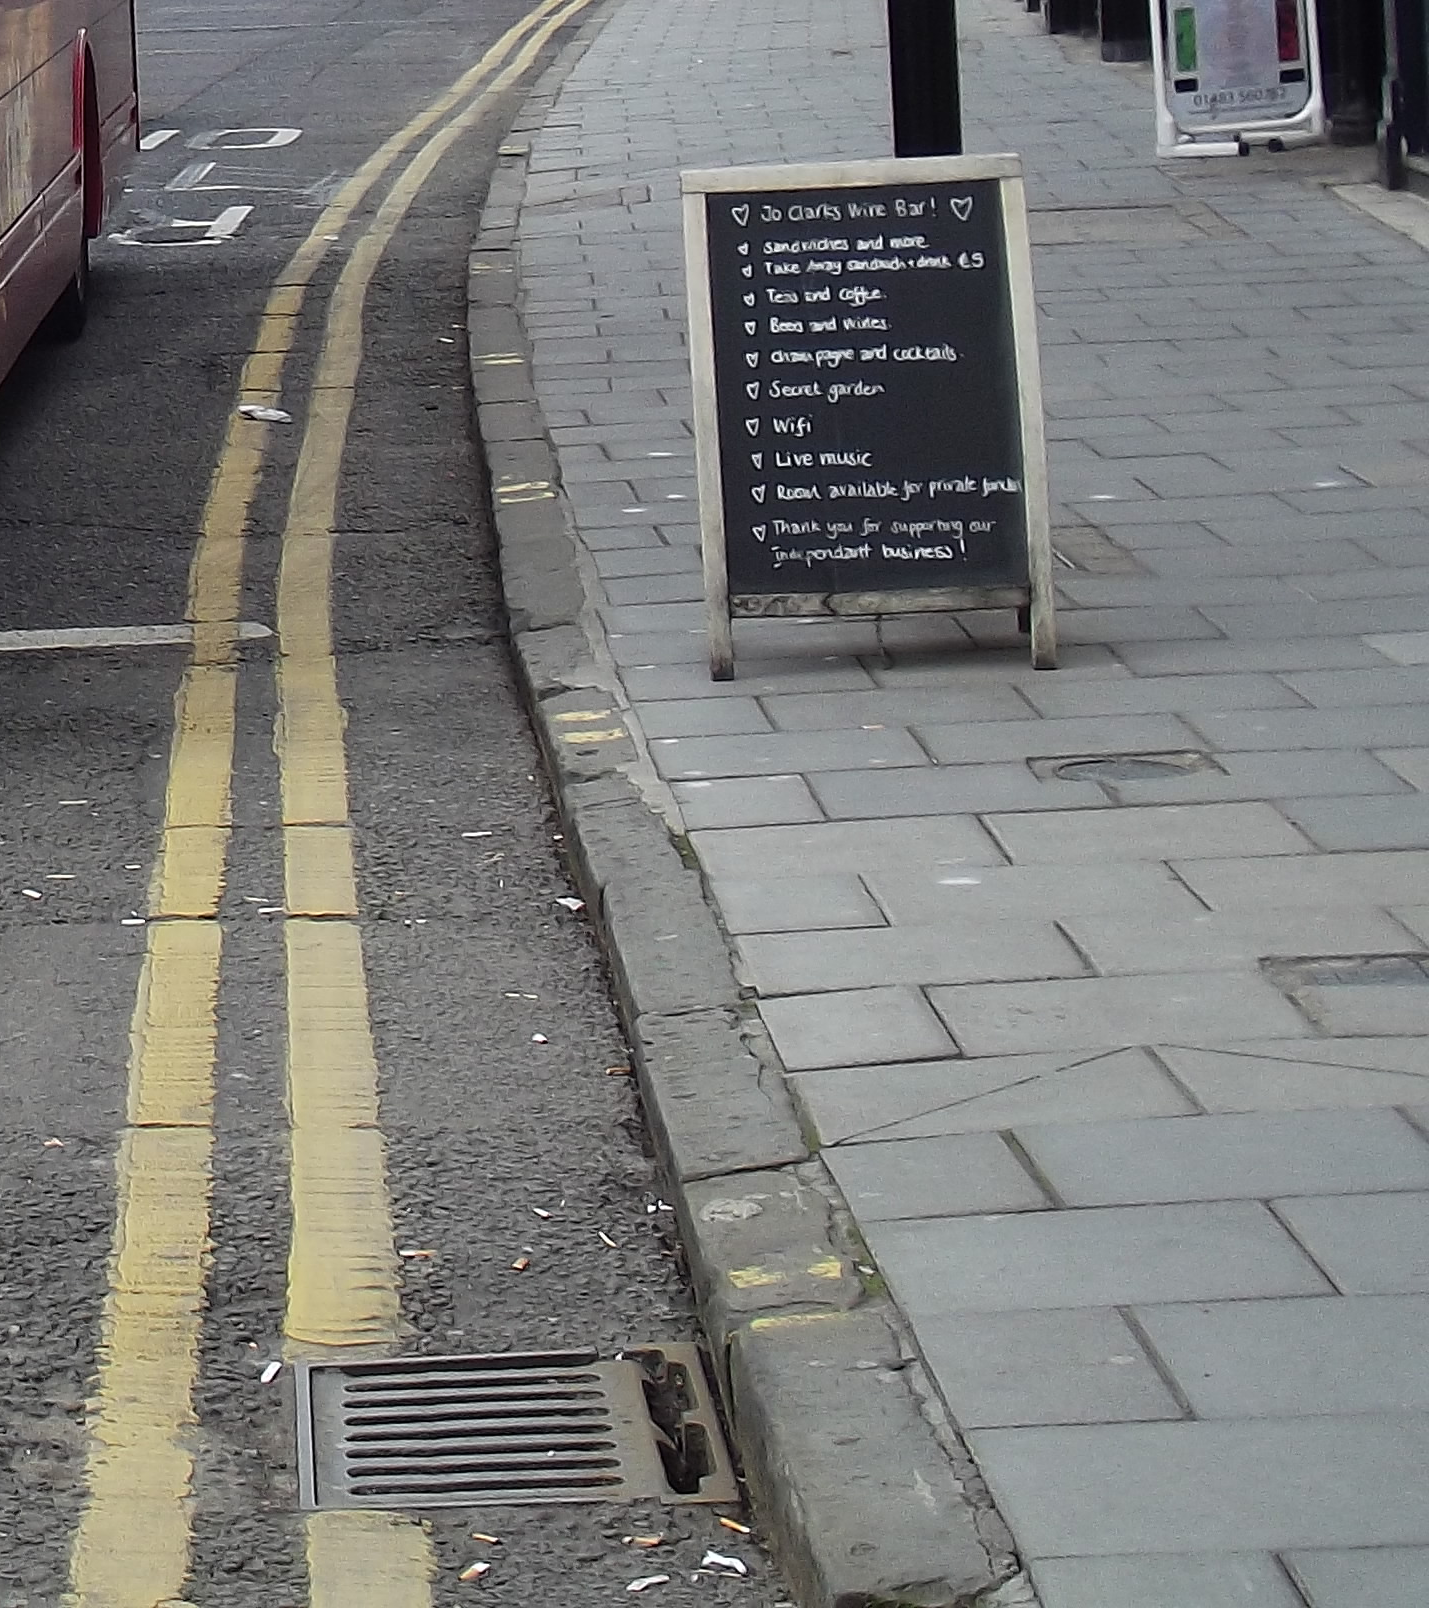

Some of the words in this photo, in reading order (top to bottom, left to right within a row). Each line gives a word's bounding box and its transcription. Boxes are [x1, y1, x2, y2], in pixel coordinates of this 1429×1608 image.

[760, 204, 782, 222] Jo
[788, 201, 843, 223] Clarks
[847, 200, 887, 219] Wine
[855, 234, 884, 251] and
[763, 261, 802, 276] Take
[765, 288, 800, 305] Teas
[804, 286, 832, 303] and
[808, 316, 838, 332] and
[859, 344, 888, 361] and
[768, 379, 823, 399] Secret
[827, 380, 886, 404] garden
[772, 413, 814, 437] Wifi
[775, 450, 814, 468] Live
[819, 448, 873, 468] music
[828, 481, 900, 500] available
[900, 480, 924, 502] for
[928, 475, 978, 499] private
[771, 519, 822, 536] Thank
[826, 520, 854, 541] you
[859, 517, 884, 537] for
[891, 518, 964, 540] supporting
[967, 519, 998, 534] our
